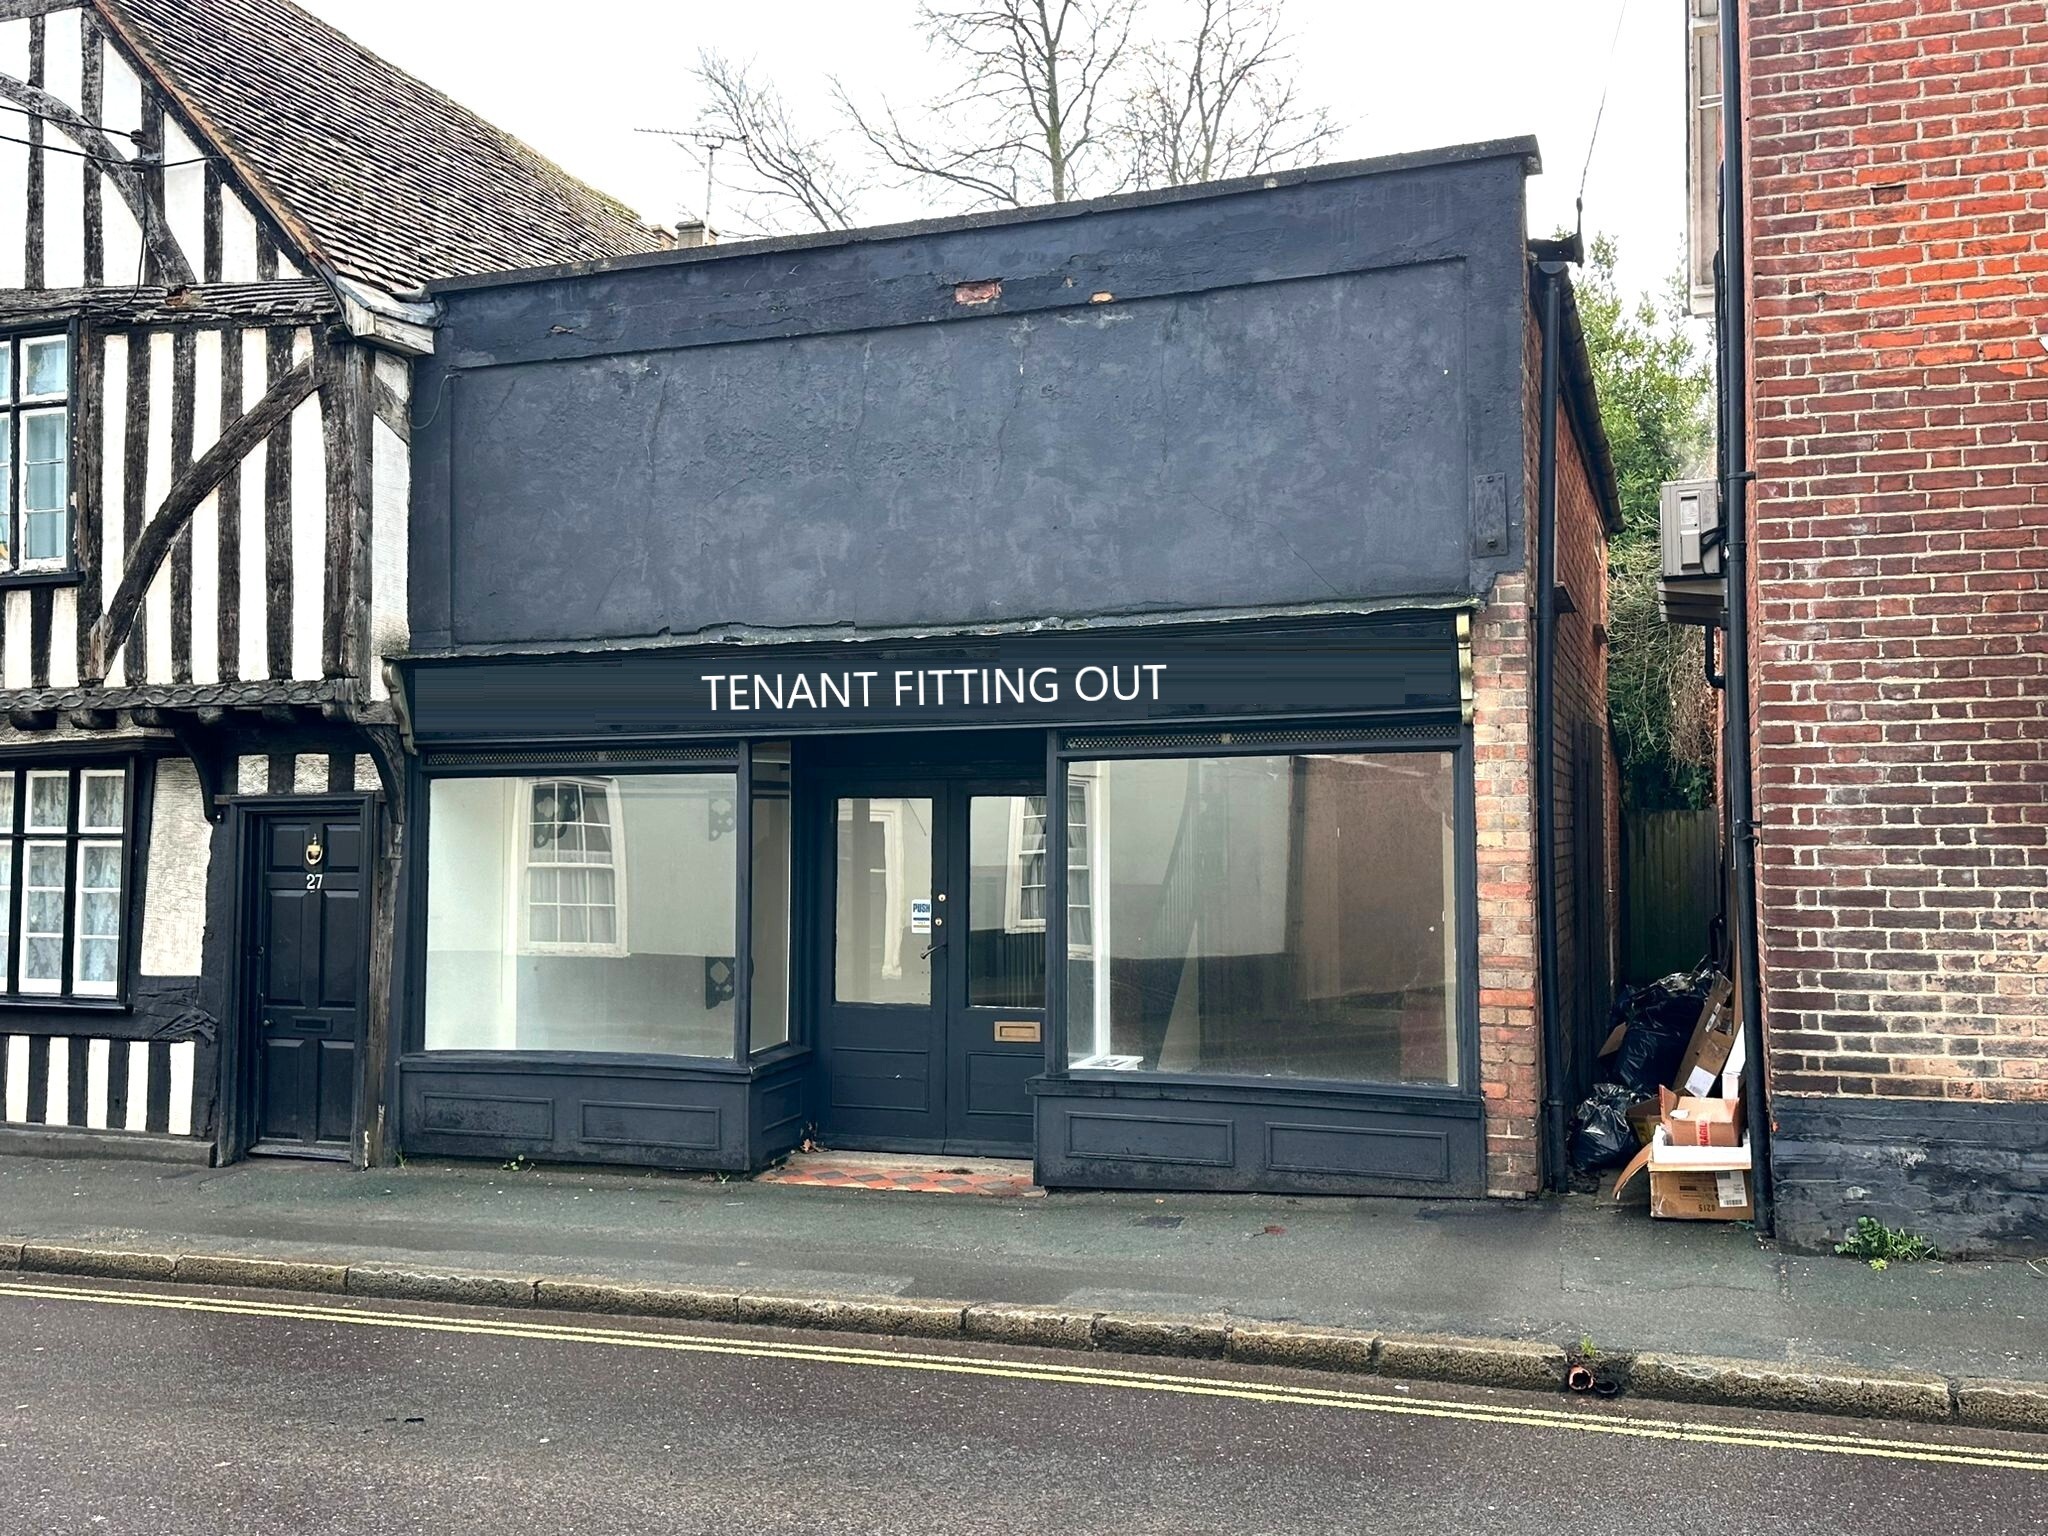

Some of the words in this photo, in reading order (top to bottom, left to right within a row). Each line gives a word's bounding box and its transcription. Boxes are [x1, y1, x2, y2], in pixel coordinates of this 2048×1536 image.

[701, 672, 877, 710] TENANT
[895, 668, 1058, 706] FITTING
[1076, 665, 1166, 701] OUT
[306, 873, 323, 890] 27
[913, 903, 931, 913] PUSH
[1699, 1120, 1709, 1147] RAGIL
